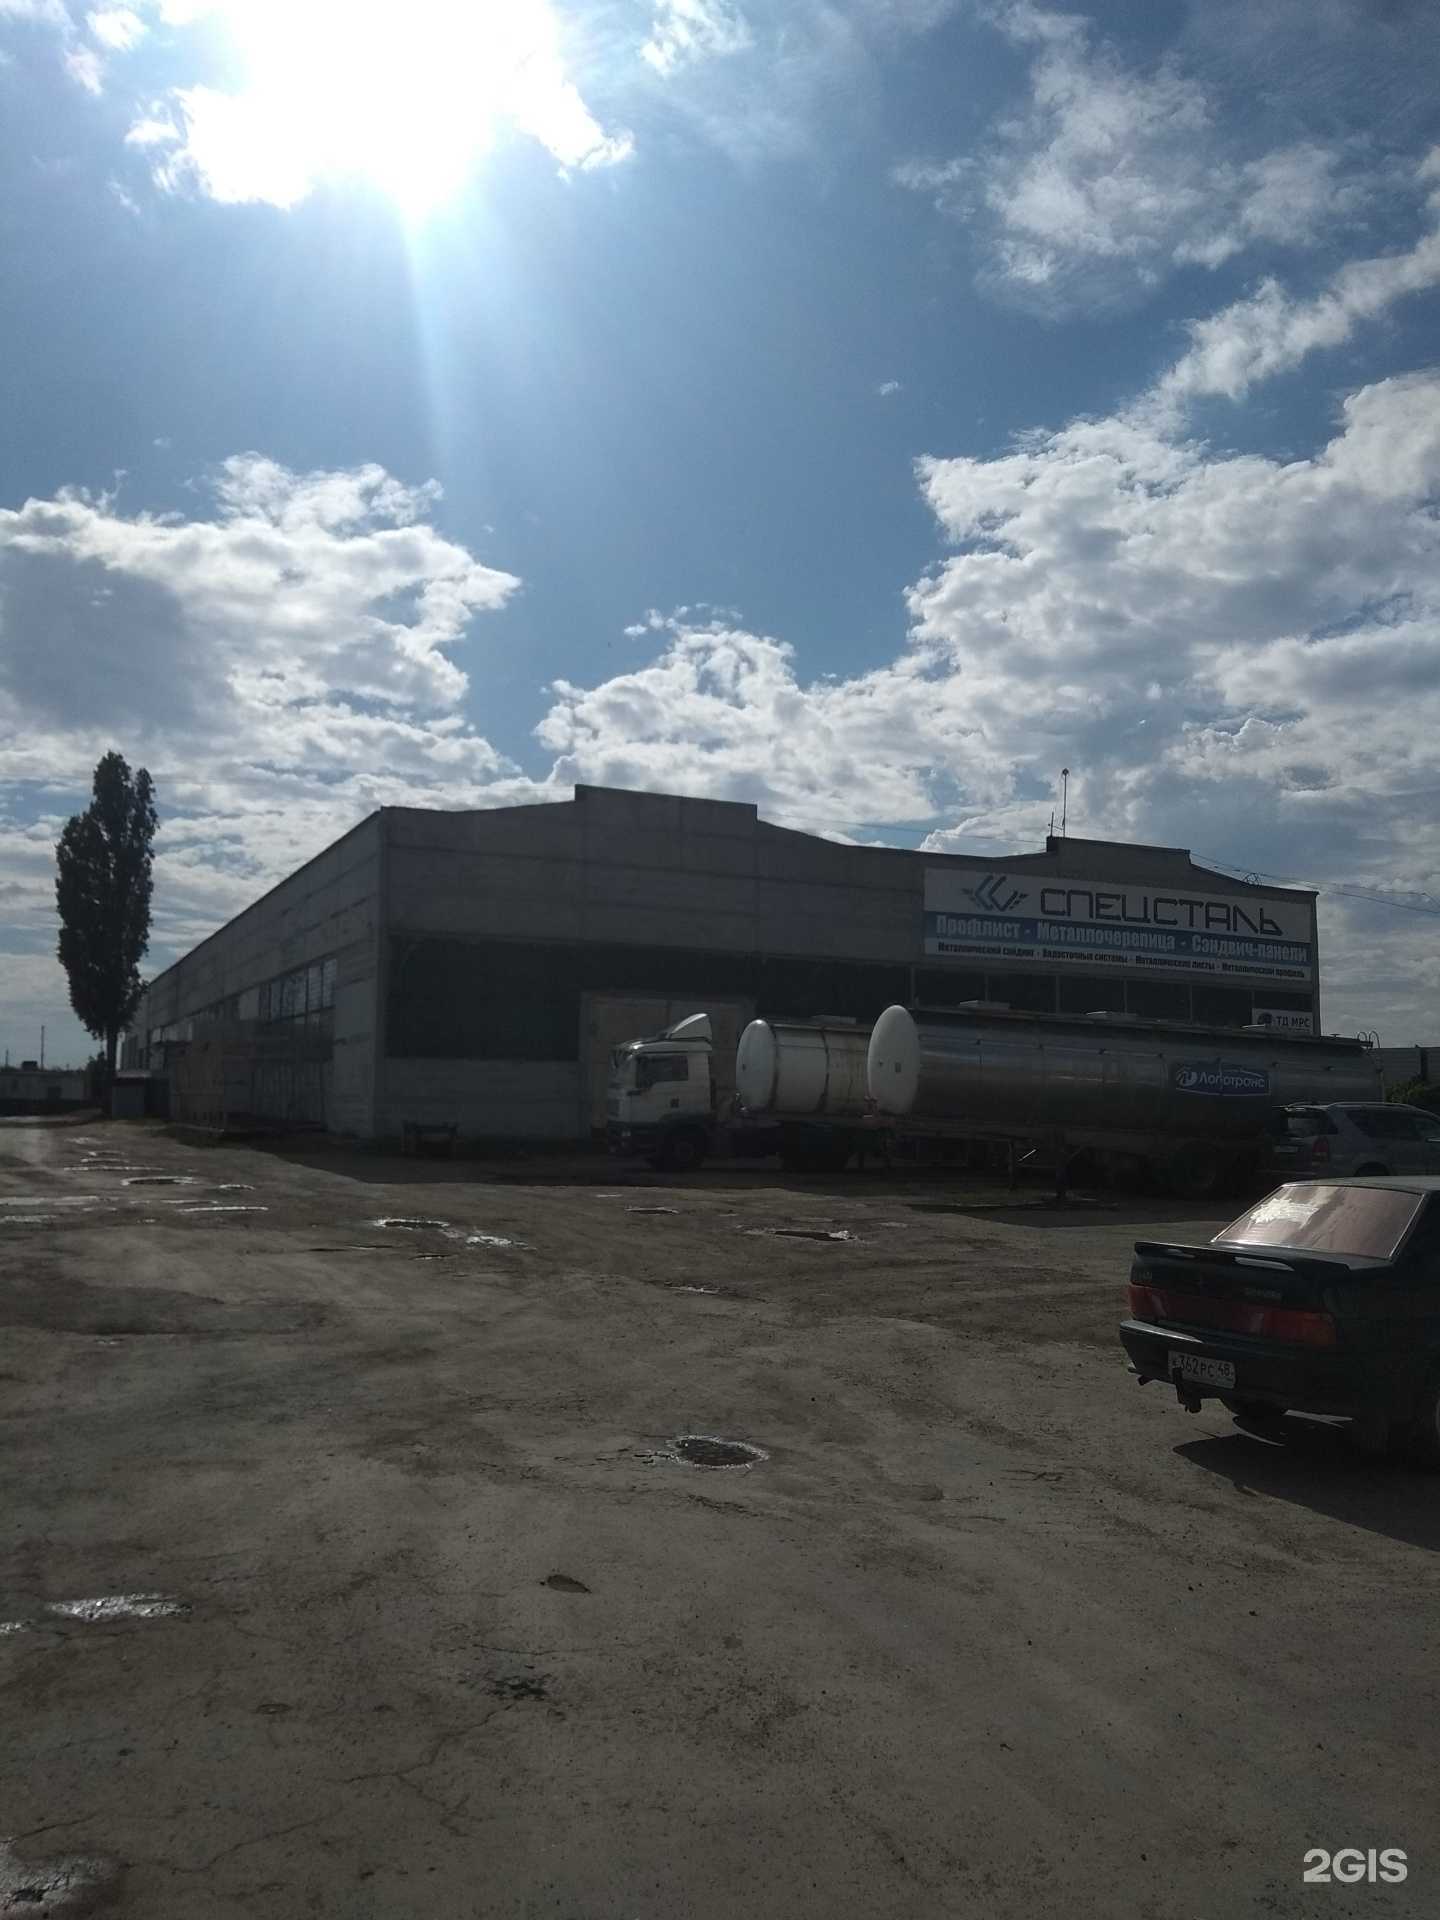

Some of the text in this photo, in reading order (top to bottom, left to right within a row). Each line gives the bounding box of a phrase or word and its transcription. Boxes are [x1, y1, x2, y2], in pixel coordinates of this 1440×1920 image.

[936, 915, 1021, 938] Профлист
[1037, 920, 1176, 951] Металлочерепица
[1041, 888, 1283, 937] СПЕЦСТАЛЬ
